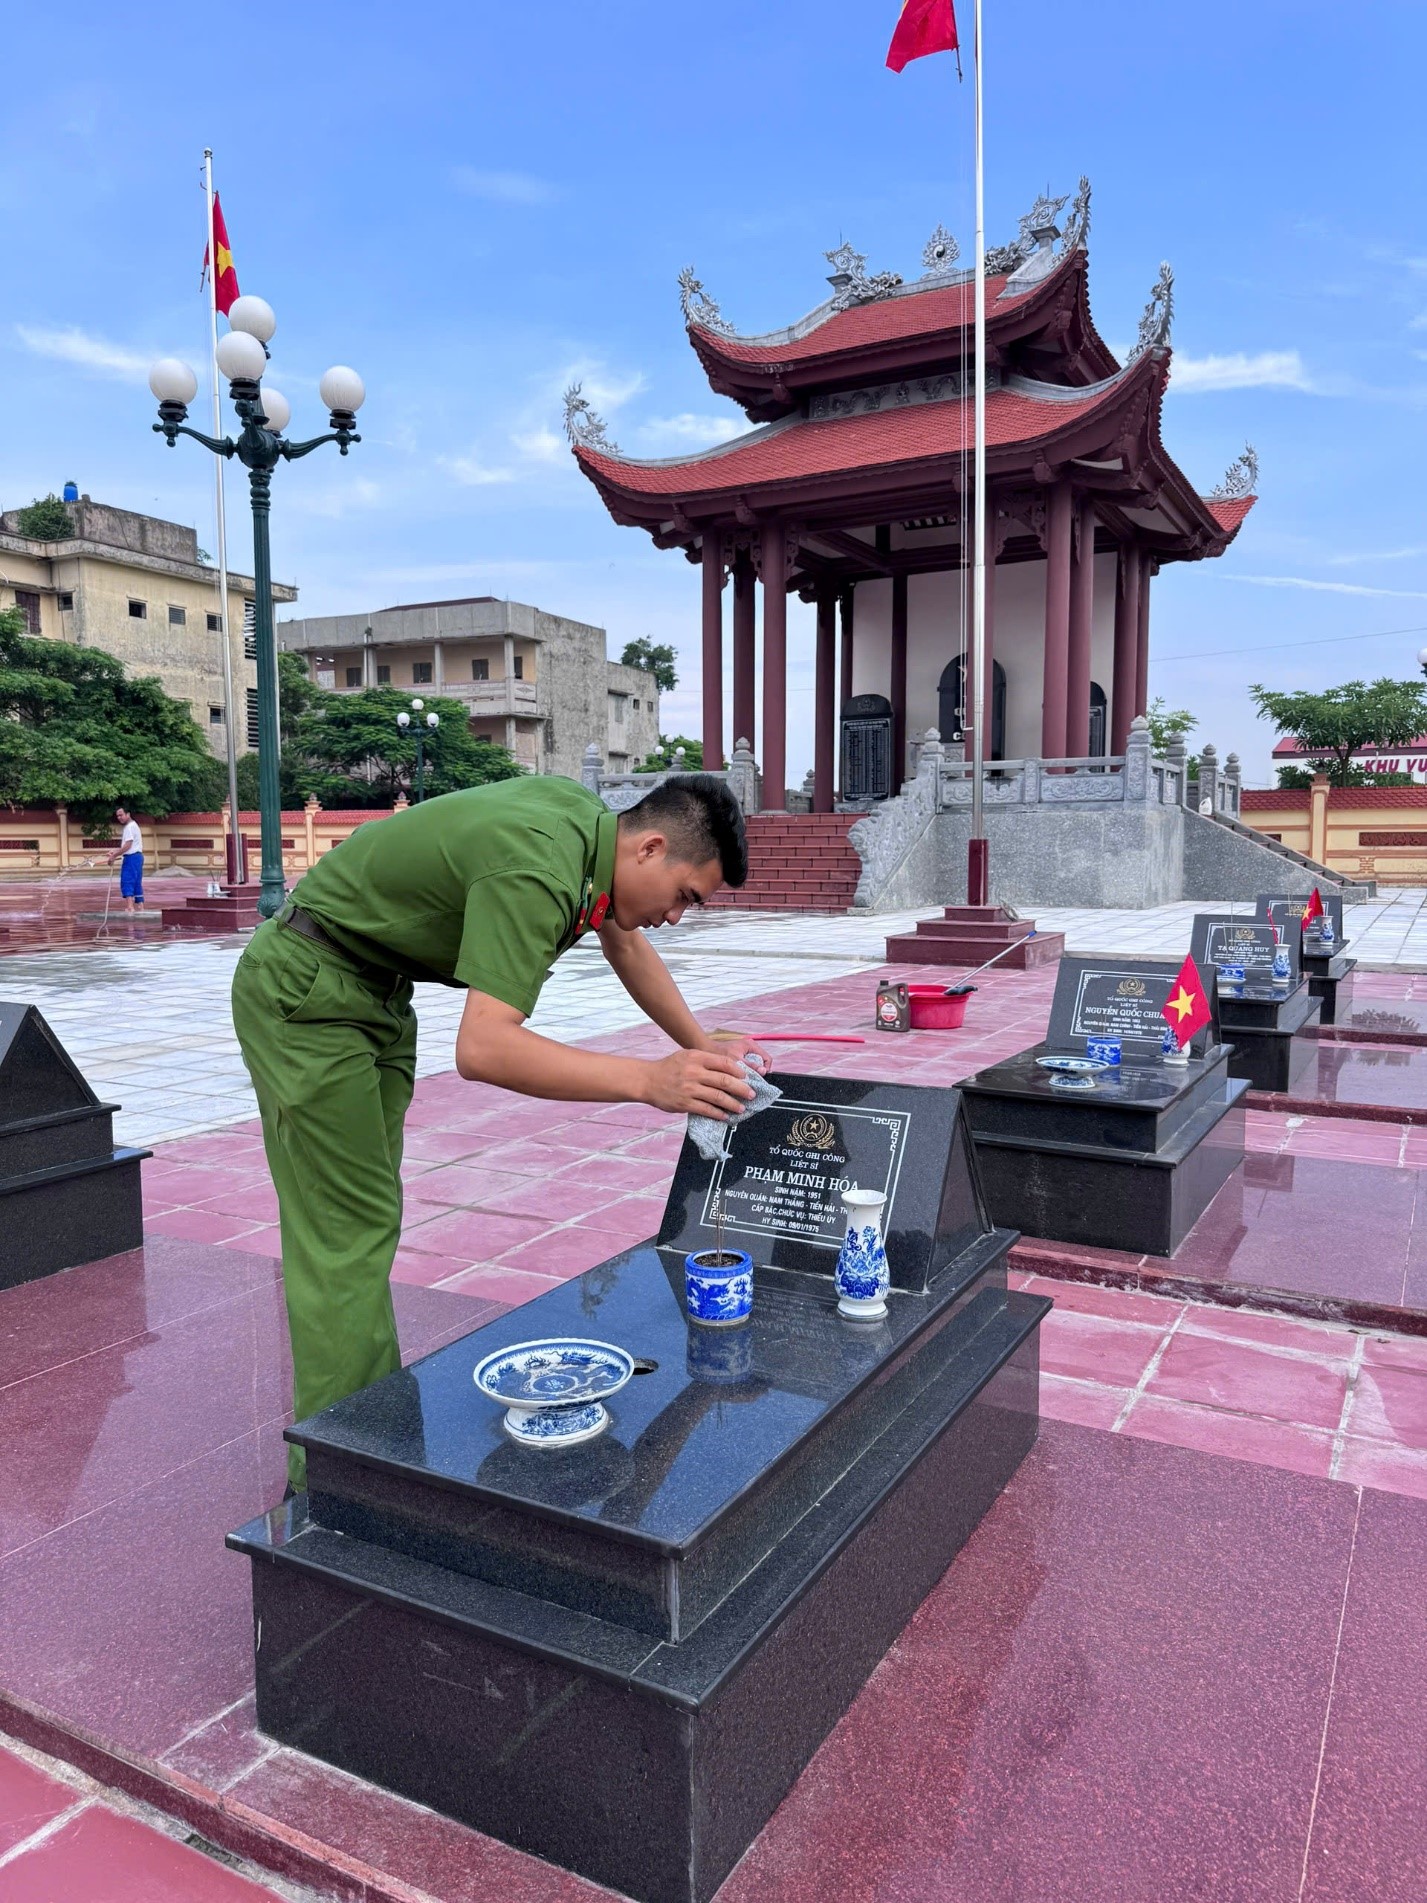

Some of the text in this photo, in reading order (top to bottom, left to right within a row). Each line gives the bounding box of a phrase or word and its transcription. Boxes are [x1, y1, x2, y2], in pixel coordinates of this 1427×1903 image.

[1364, 759, 1400, 773] KHU
[1119, 1007, 1142, 1018] QUỐC
[781, 1147, 804, 1158] QUỐC
[805, 1151, 821, 1160] GHI
[822, 1153, 845, 1163] CÔNG
[790, 1159, 809, 1170] LIỆT
[744, 1166, 859, 1192] PHẠM MINH HÓA
[774, 1186, 789, 1195] SINH
[807, 1191, 822, 1200] 1951
[768, 1195, 784, 1205] NAM
[762, 1217, 771, 1225] HY
